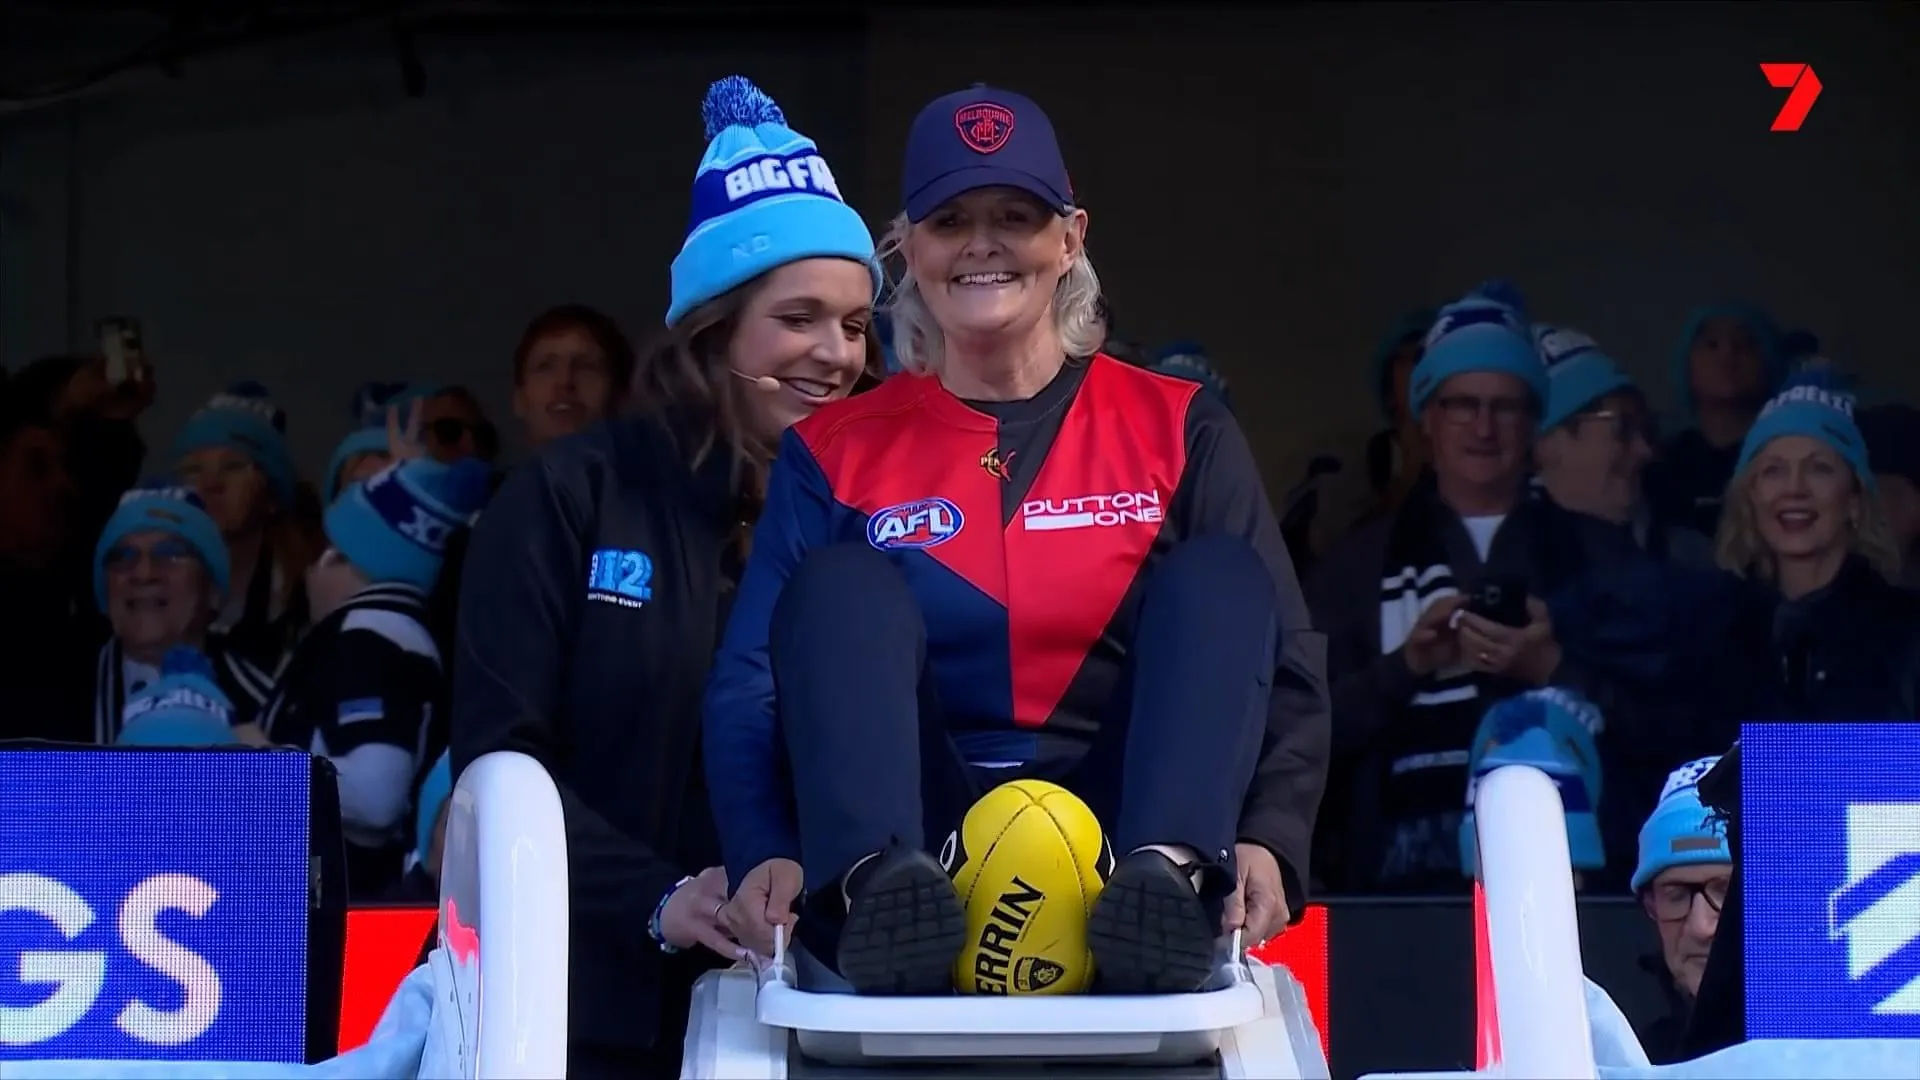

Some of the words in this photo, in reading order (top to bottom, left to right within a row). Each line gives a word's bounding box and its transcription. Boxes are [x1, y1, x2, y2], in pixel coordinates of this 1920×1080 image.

[960, 107, 1011, 126] MELBOURNE
[1023, 489, 1160, 517] DUTTON
[1094, 507, 1162, 527] ONE
[875, 507, 955, 544] AFL
[600, 550, 652, 600] 12
